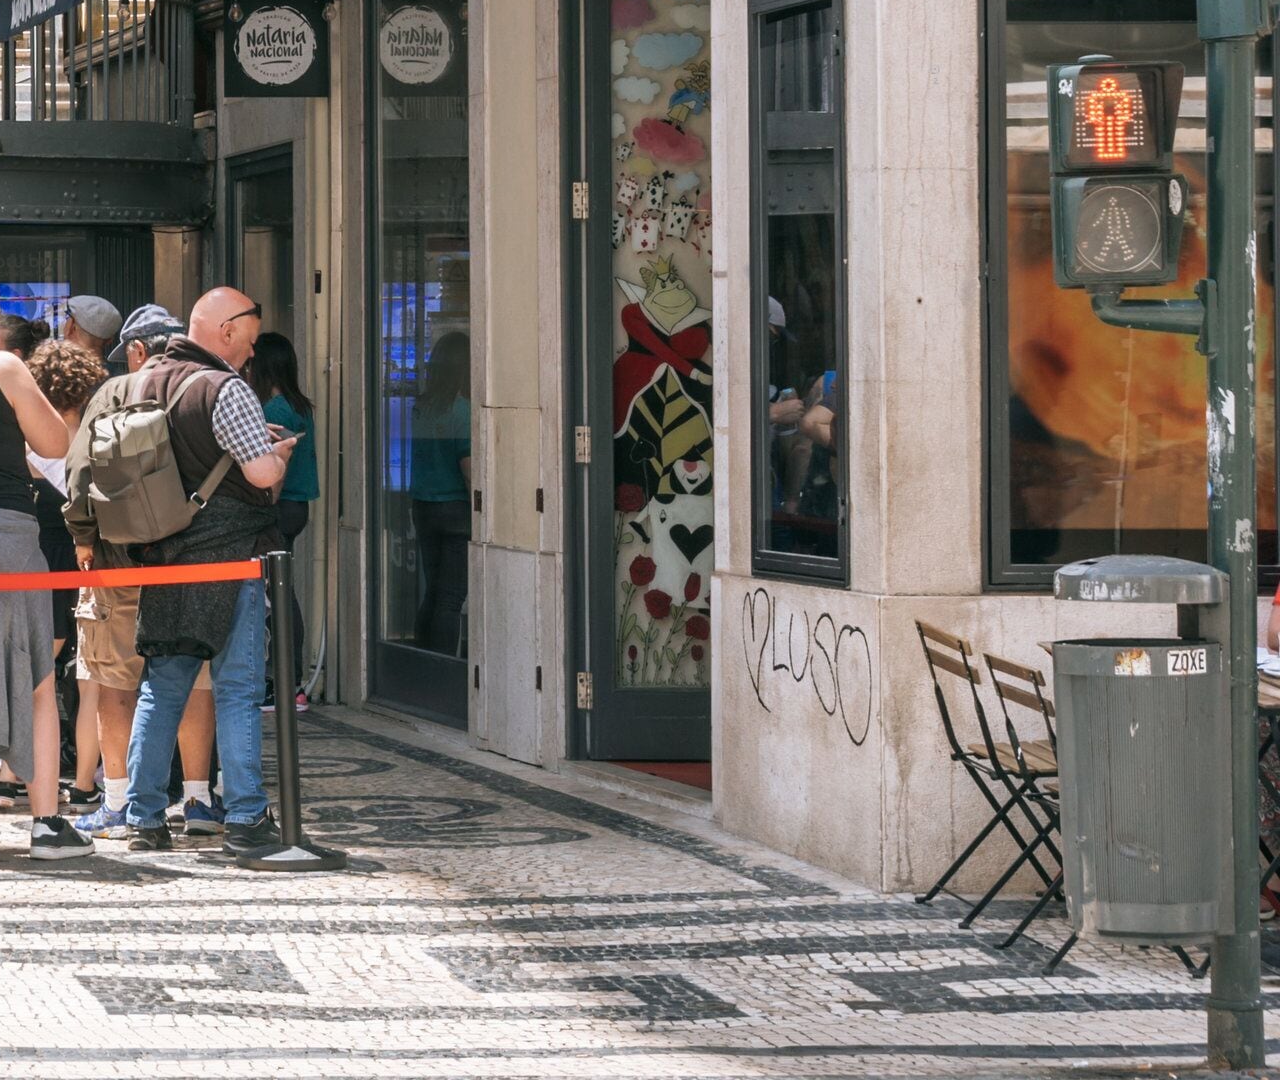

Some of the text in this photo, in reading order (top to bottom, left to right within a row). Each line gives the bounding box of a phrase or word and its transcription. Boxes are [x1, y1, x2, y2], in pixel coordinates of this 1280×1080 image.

[246, 24, 306, 47] Nataria
[250, 44, 303, 58] Nacional
[1170, 651, 1205, 671] ZOXE
